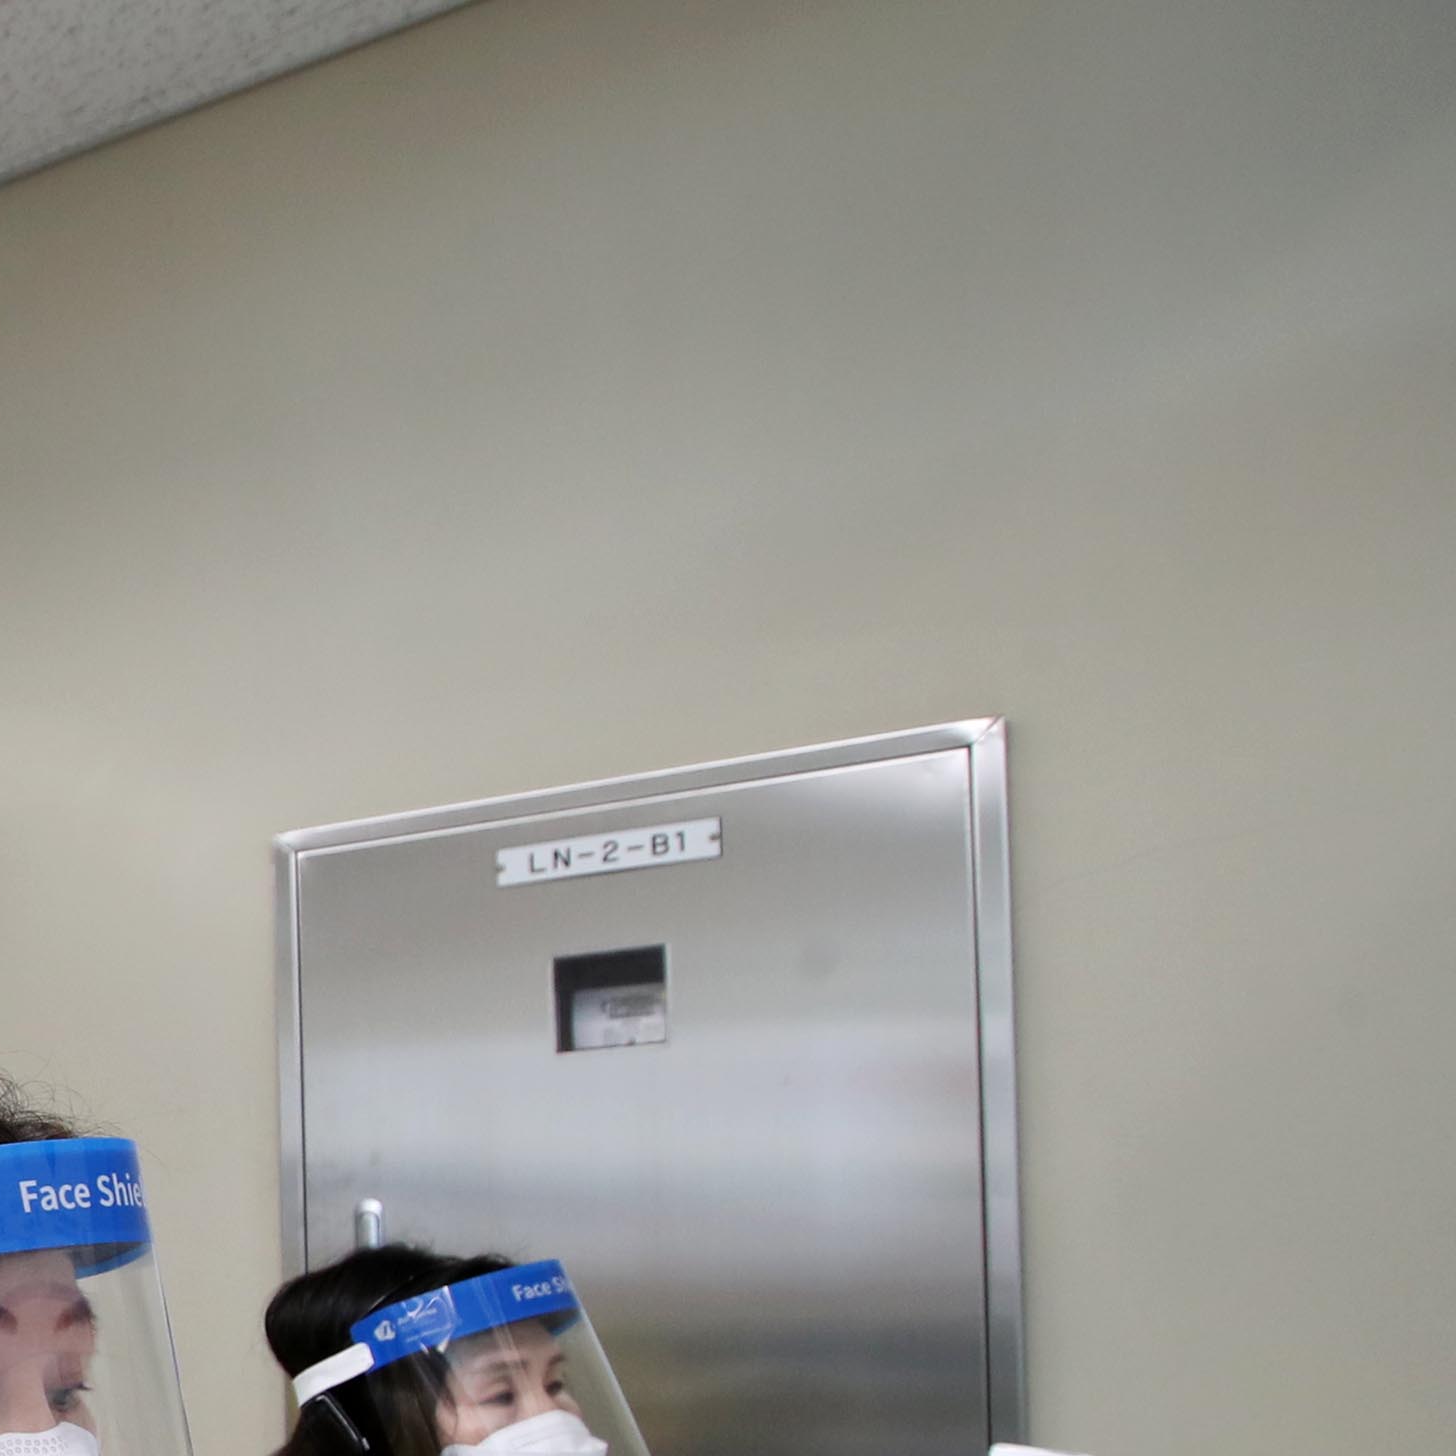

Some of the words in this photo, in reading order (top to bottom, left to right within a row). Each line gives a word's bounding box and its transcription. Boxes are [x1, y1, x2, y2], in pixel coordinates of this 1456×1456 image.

[528, 831, 686, 873] LN-2-B1
[18, 1180, 91, 1213] Face
[512, 1281, 552, 1302] Face
